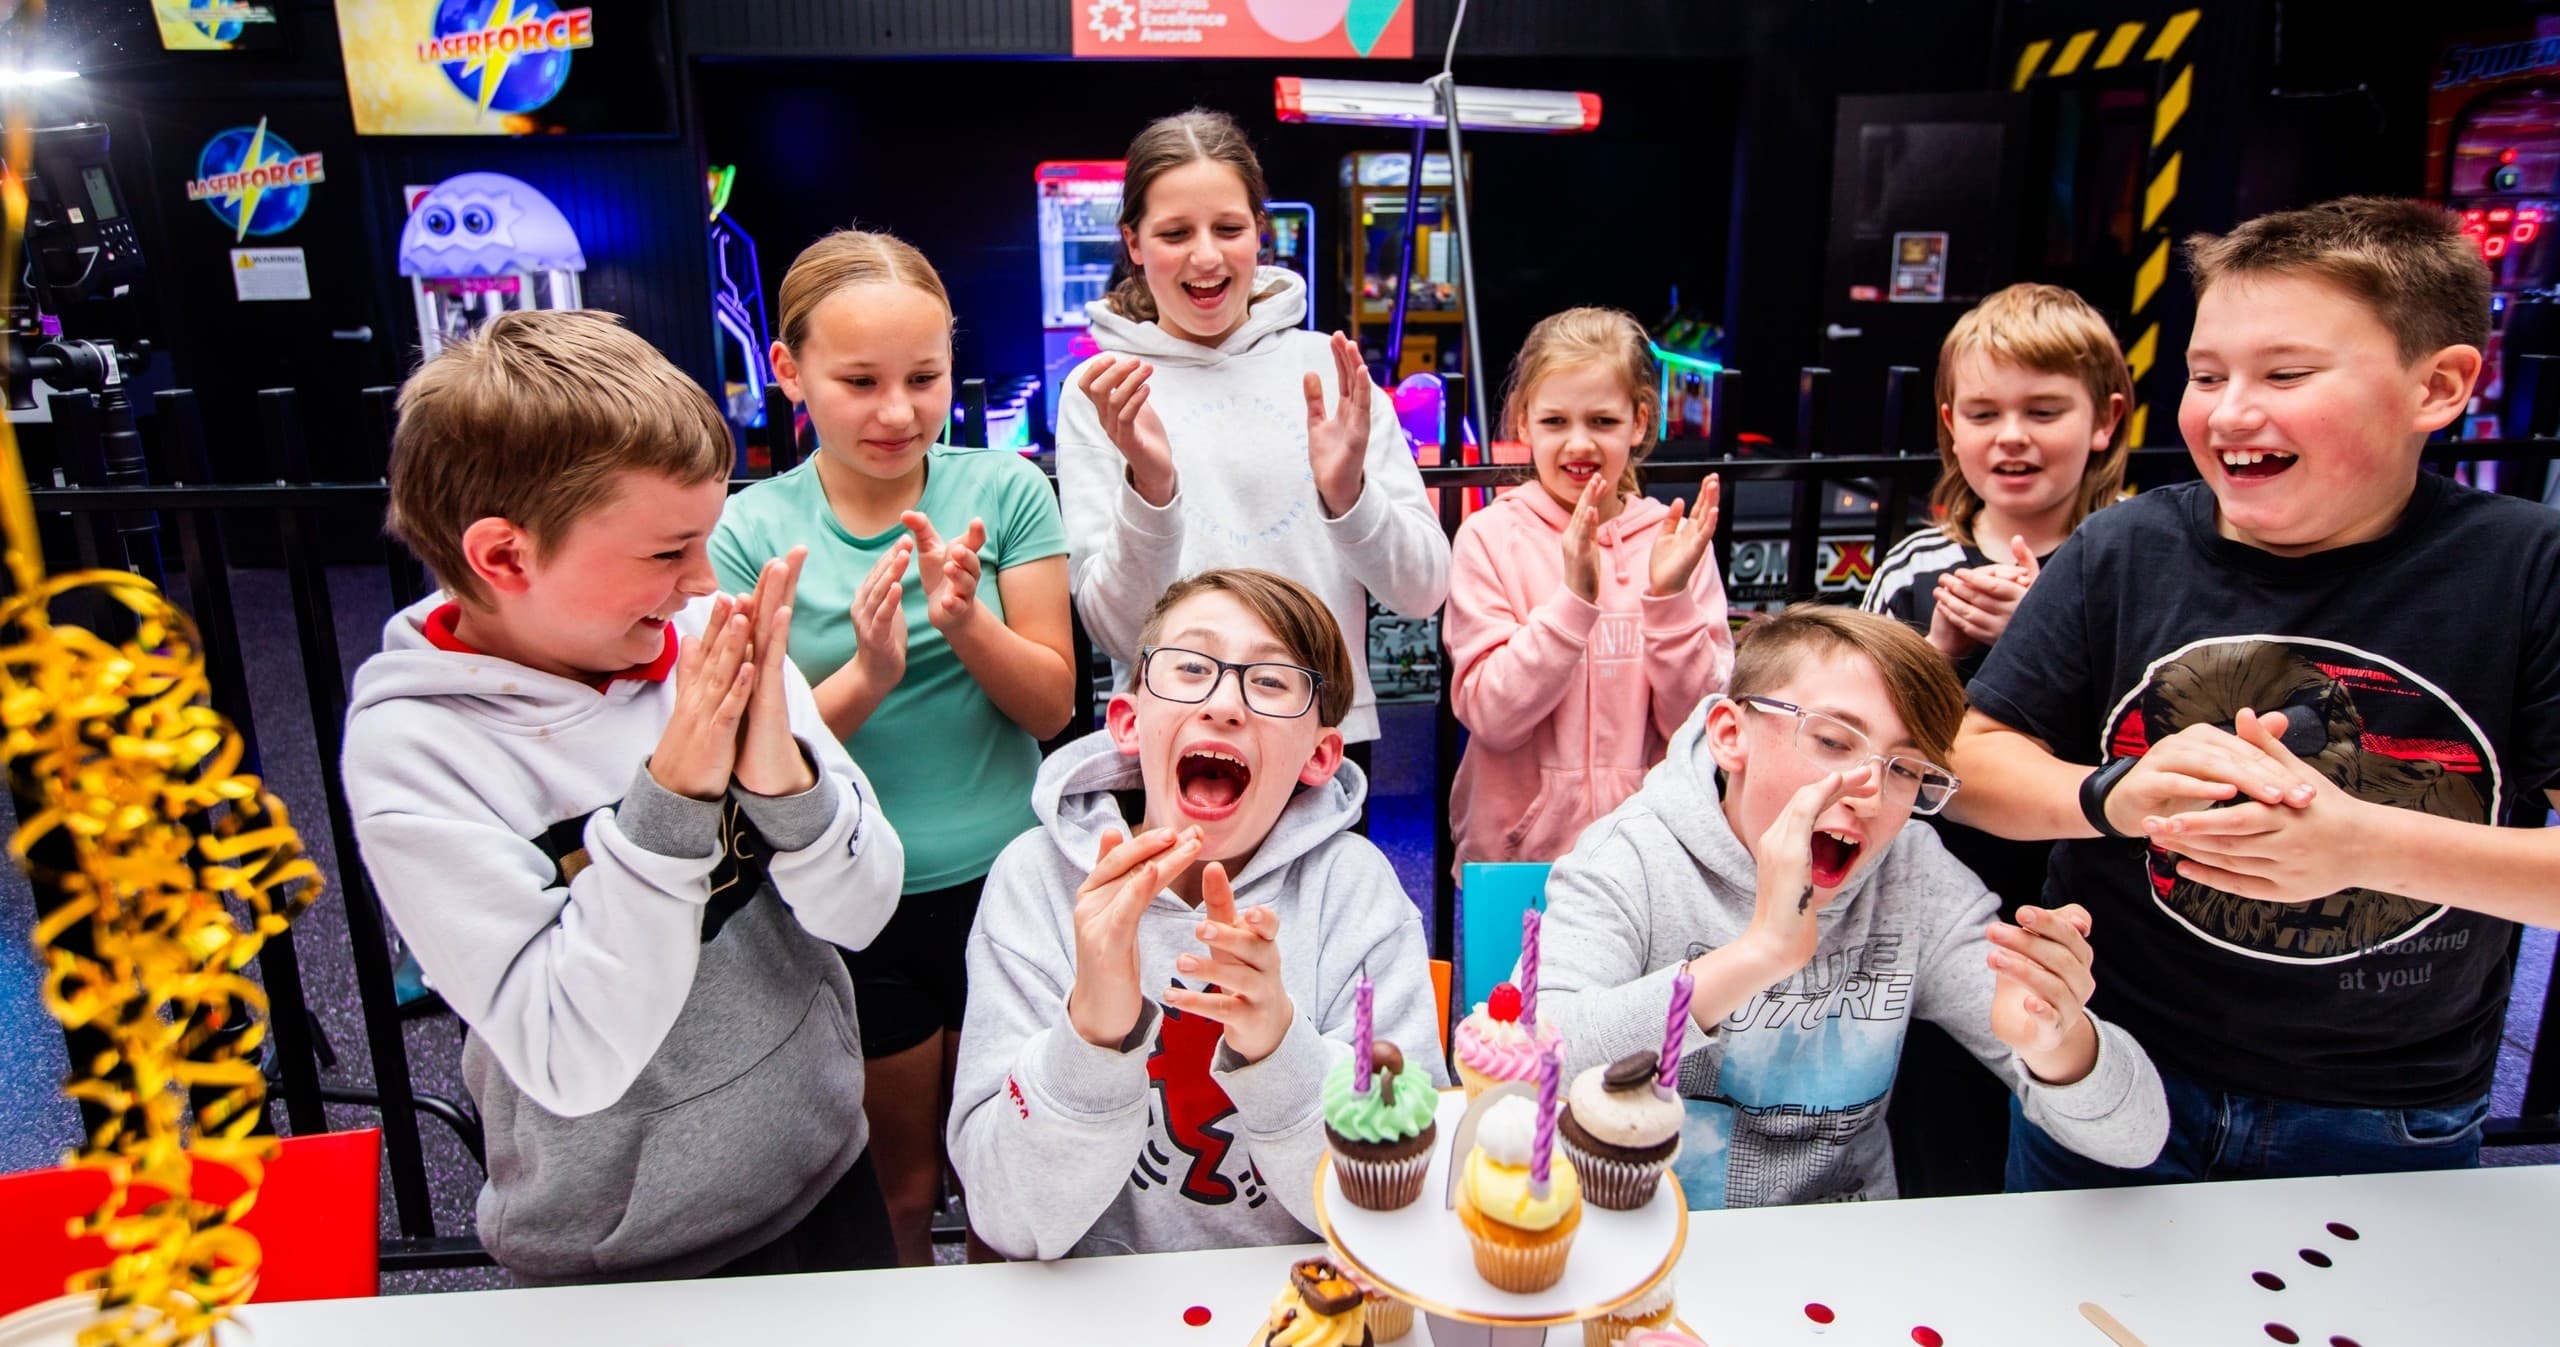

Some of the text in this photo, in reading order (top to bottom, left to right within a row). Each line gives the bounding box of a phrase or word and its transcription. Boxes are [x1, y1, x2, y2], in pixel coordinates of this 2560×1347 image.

[1139, 10, 1228, 26] Excellence
[417, 8, 593, 64] LASERFORCE
[1139, 27, 1203, 42] Awards
[187, 153, 325, 200] LASERFORCE
[252, 255, 302, 264] WARNING
[2339, 962, 2432, 993] at you!
